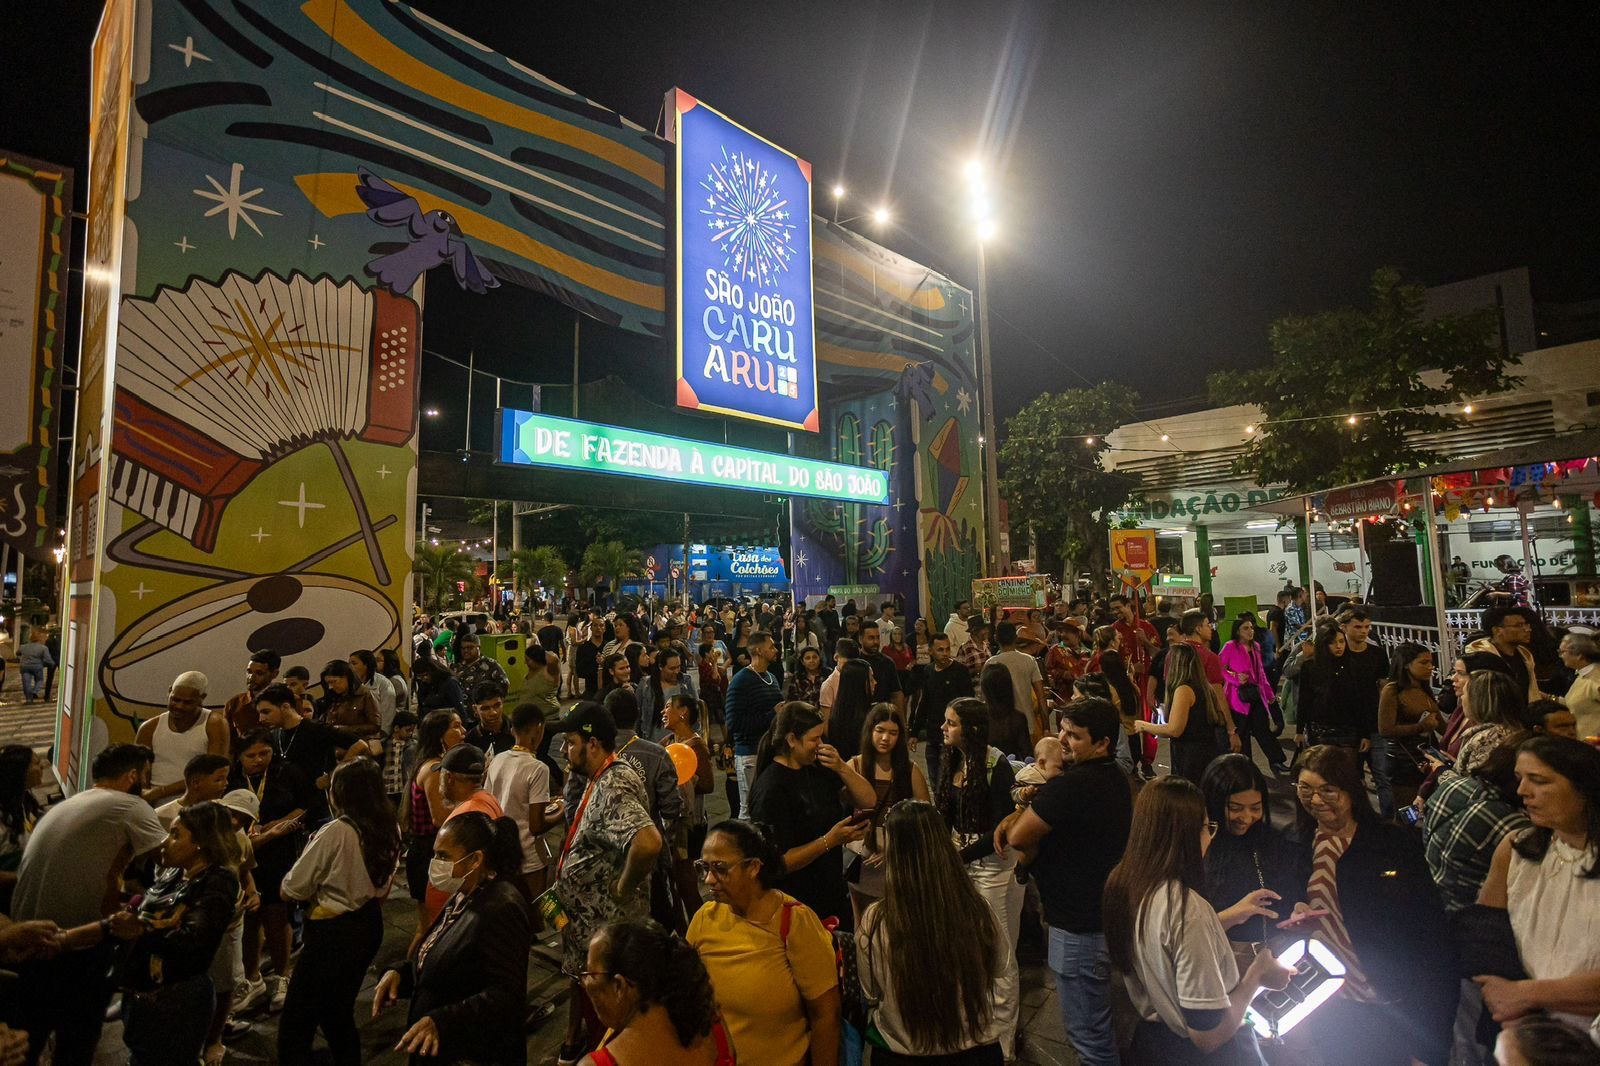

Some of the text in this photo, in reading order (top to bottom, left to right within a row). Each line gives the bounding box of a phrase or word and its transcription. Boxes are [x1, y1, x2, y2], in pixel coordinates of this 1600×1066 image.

[705, 268, 795, 327] SÃO JOÃO
[703, 305, 798, 363] CARU
[703, 343, 777, 394] ARU
[535, 427, 881, 497] DE FAZENDA À CAPITAL DO SÃO JOÃO
[1330, 496, 1391, 516] SEBASTIÃO BIANO
[730, 561, 779, 574] Colchões
[1550, 558, 1569, 566] DE
[629, 755, 647, 782] INDIGO
